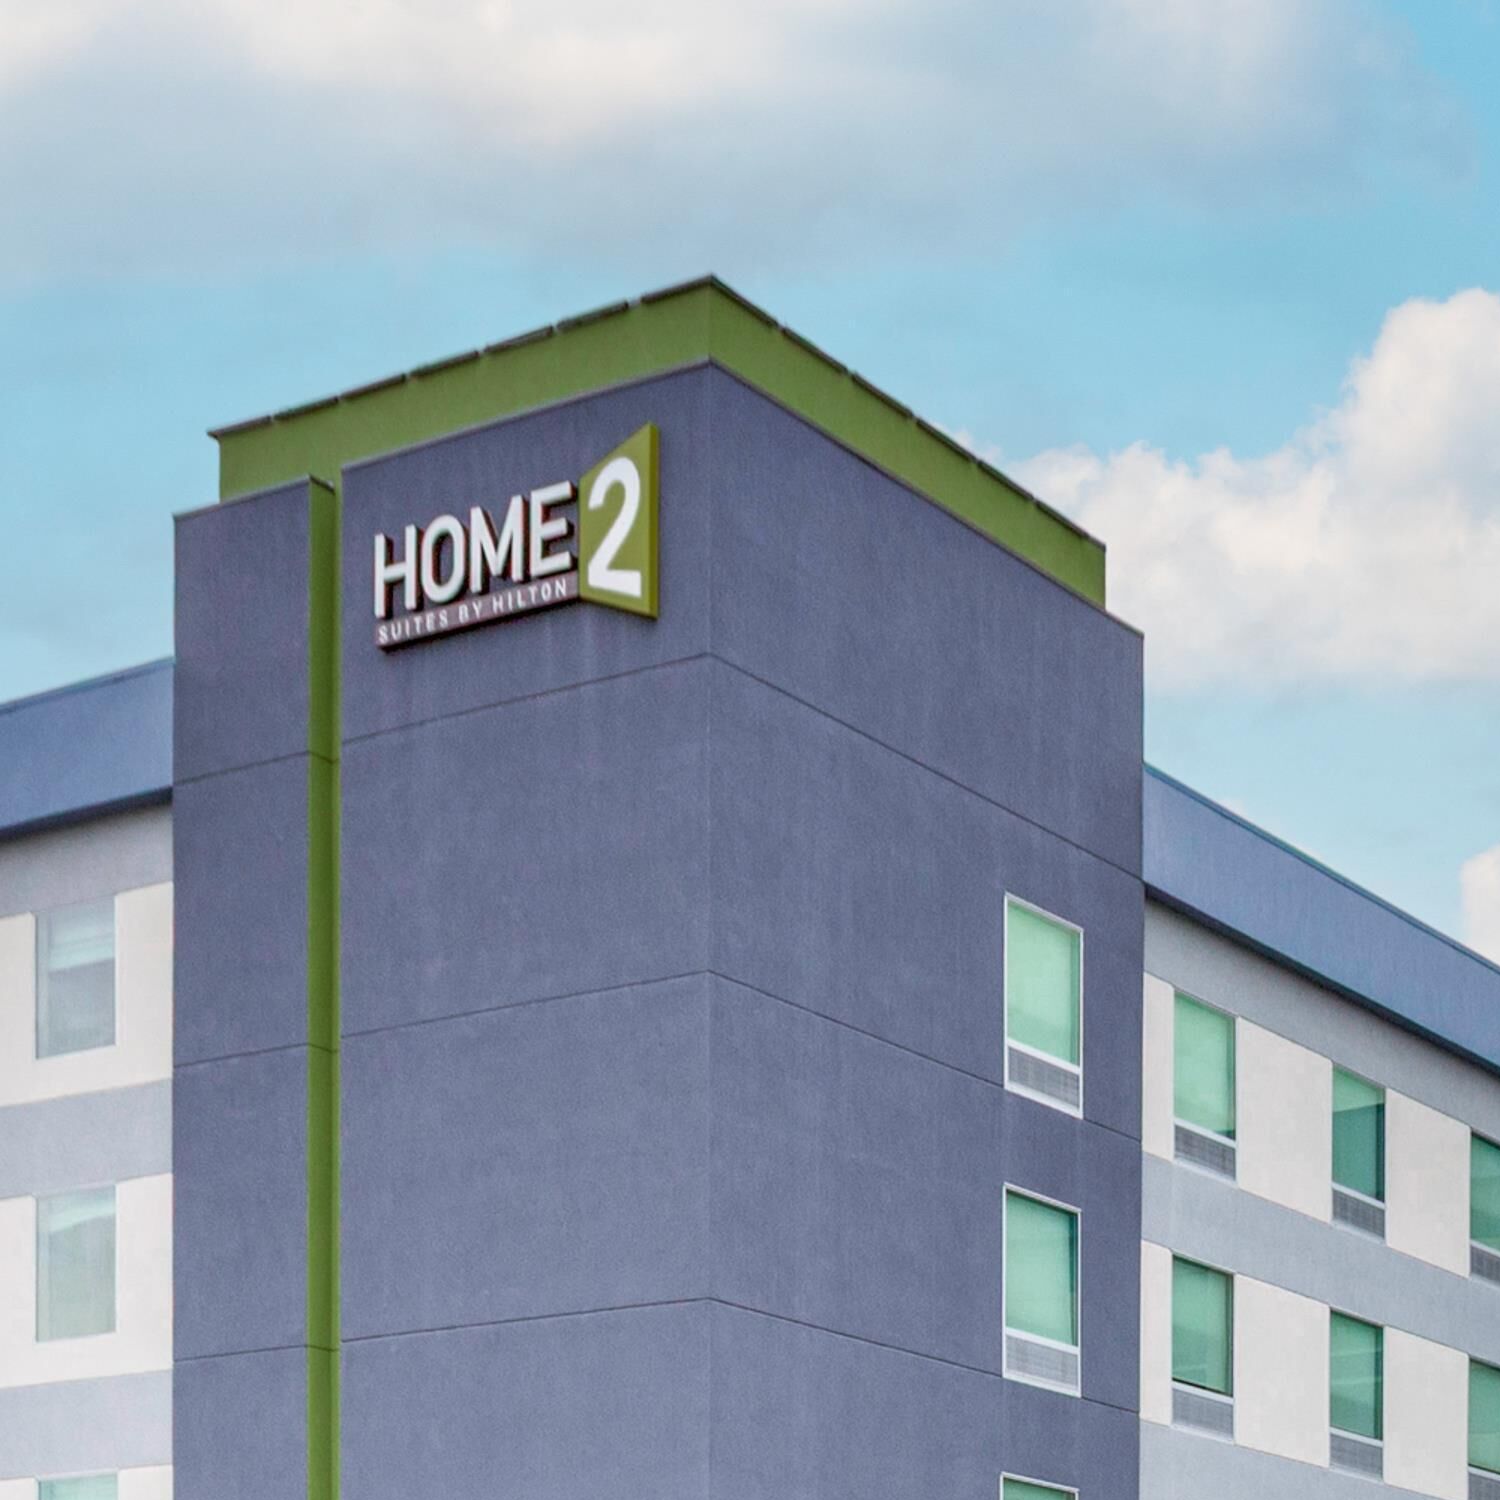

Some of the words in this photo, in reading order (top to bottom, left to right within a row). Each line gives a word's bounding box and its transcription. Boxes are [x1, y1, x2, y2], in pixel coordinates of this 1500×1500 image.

[374, 480, 574, 619] HOME
[587, 455, 642, 598] 2
[378, 609, 449, 644] SUITES
[458, 602, 484, 624] BY
[492, 578, 567, 613] HILTON
